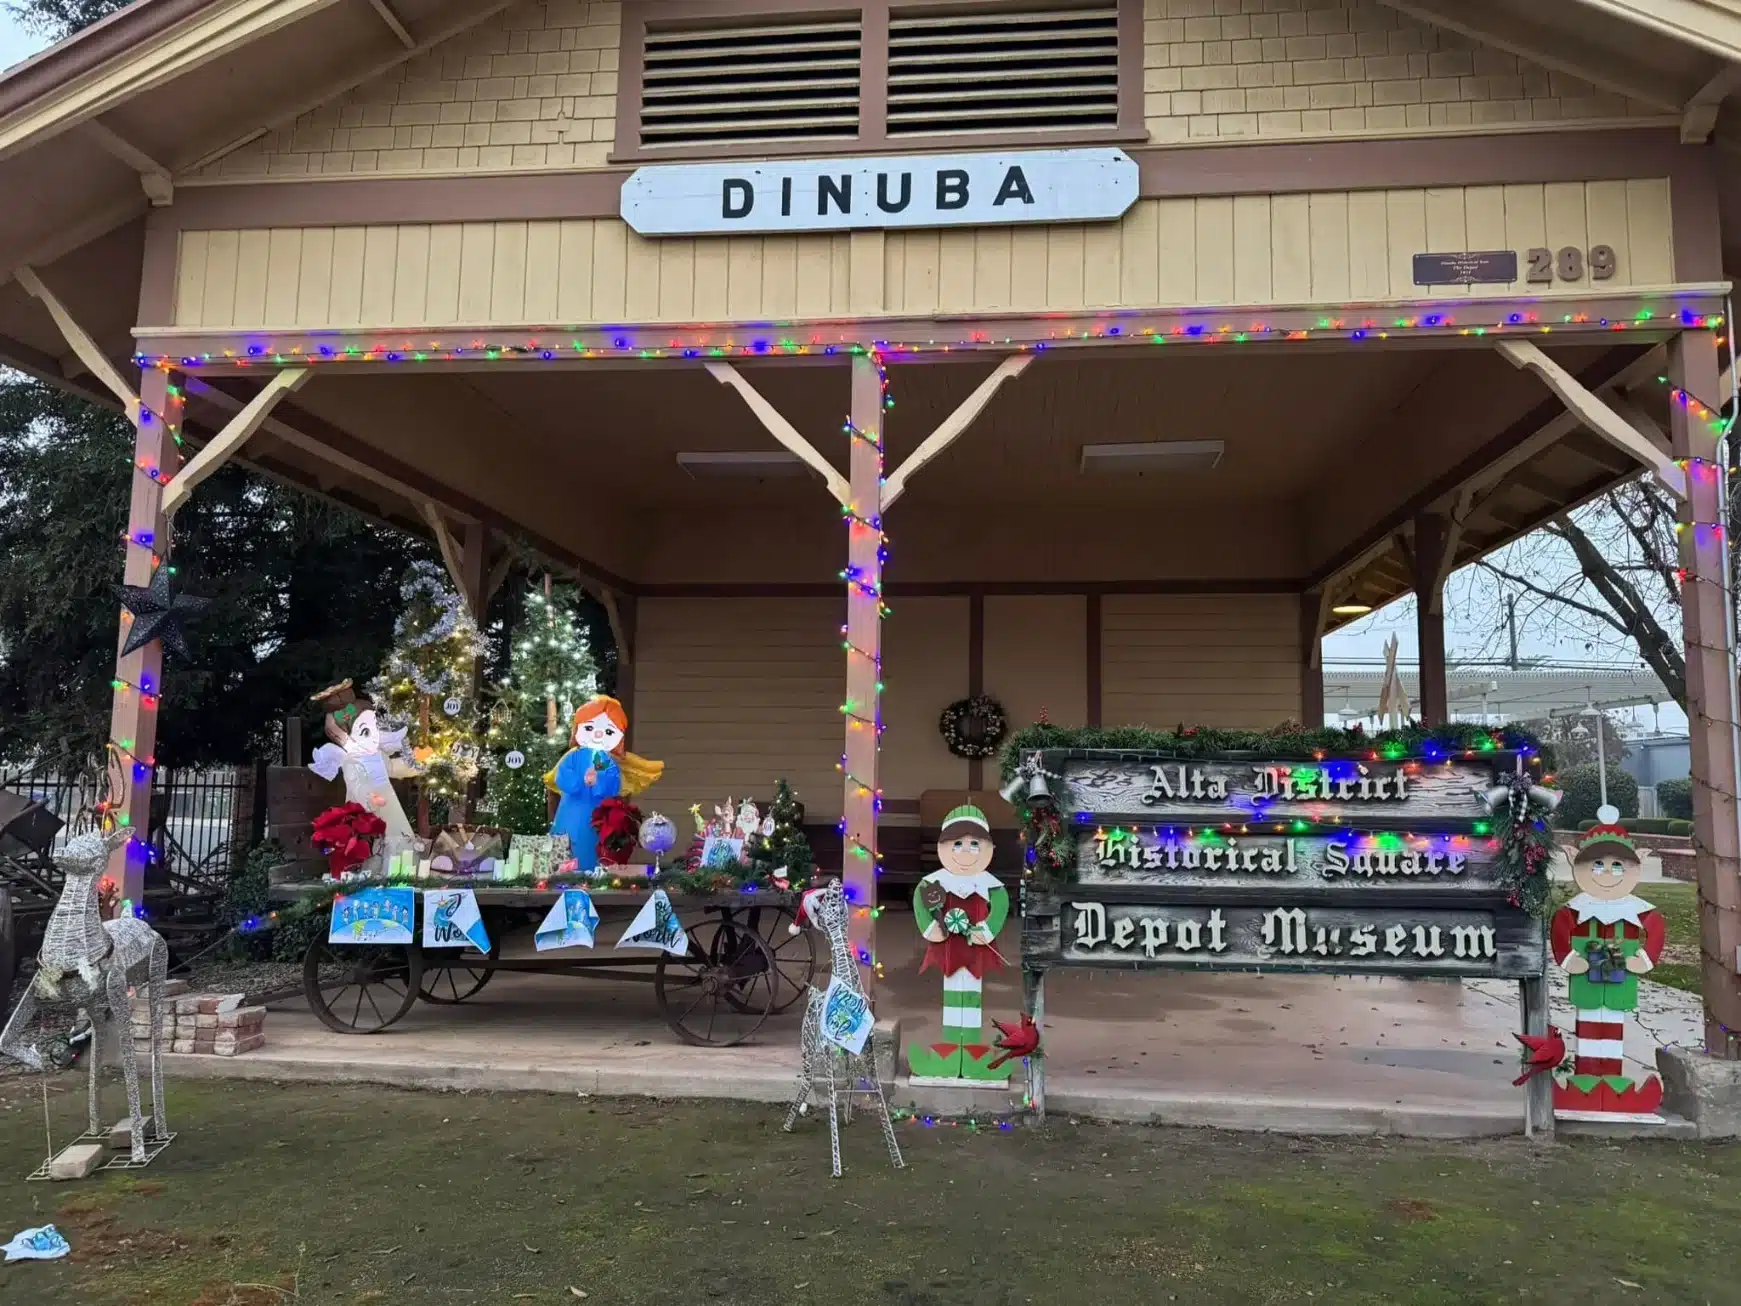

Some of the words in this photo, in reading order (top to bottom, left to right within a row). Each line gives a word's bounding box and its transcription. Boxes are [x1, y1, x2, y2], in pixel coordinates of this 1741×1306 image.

[721, 165, 1035, 219] DINUBA
[1527, 244, 1616, 284] 289
[1141, 765, 1228, 804] Alta
[1251, 765, 1409, 805] District
[1094, 833, 1299, 873] Historical
[1322, 842, 1466, 878] Square
[1071, 901, 1228, 958] Depot
[1257, 907, 1497, 959] Museum
